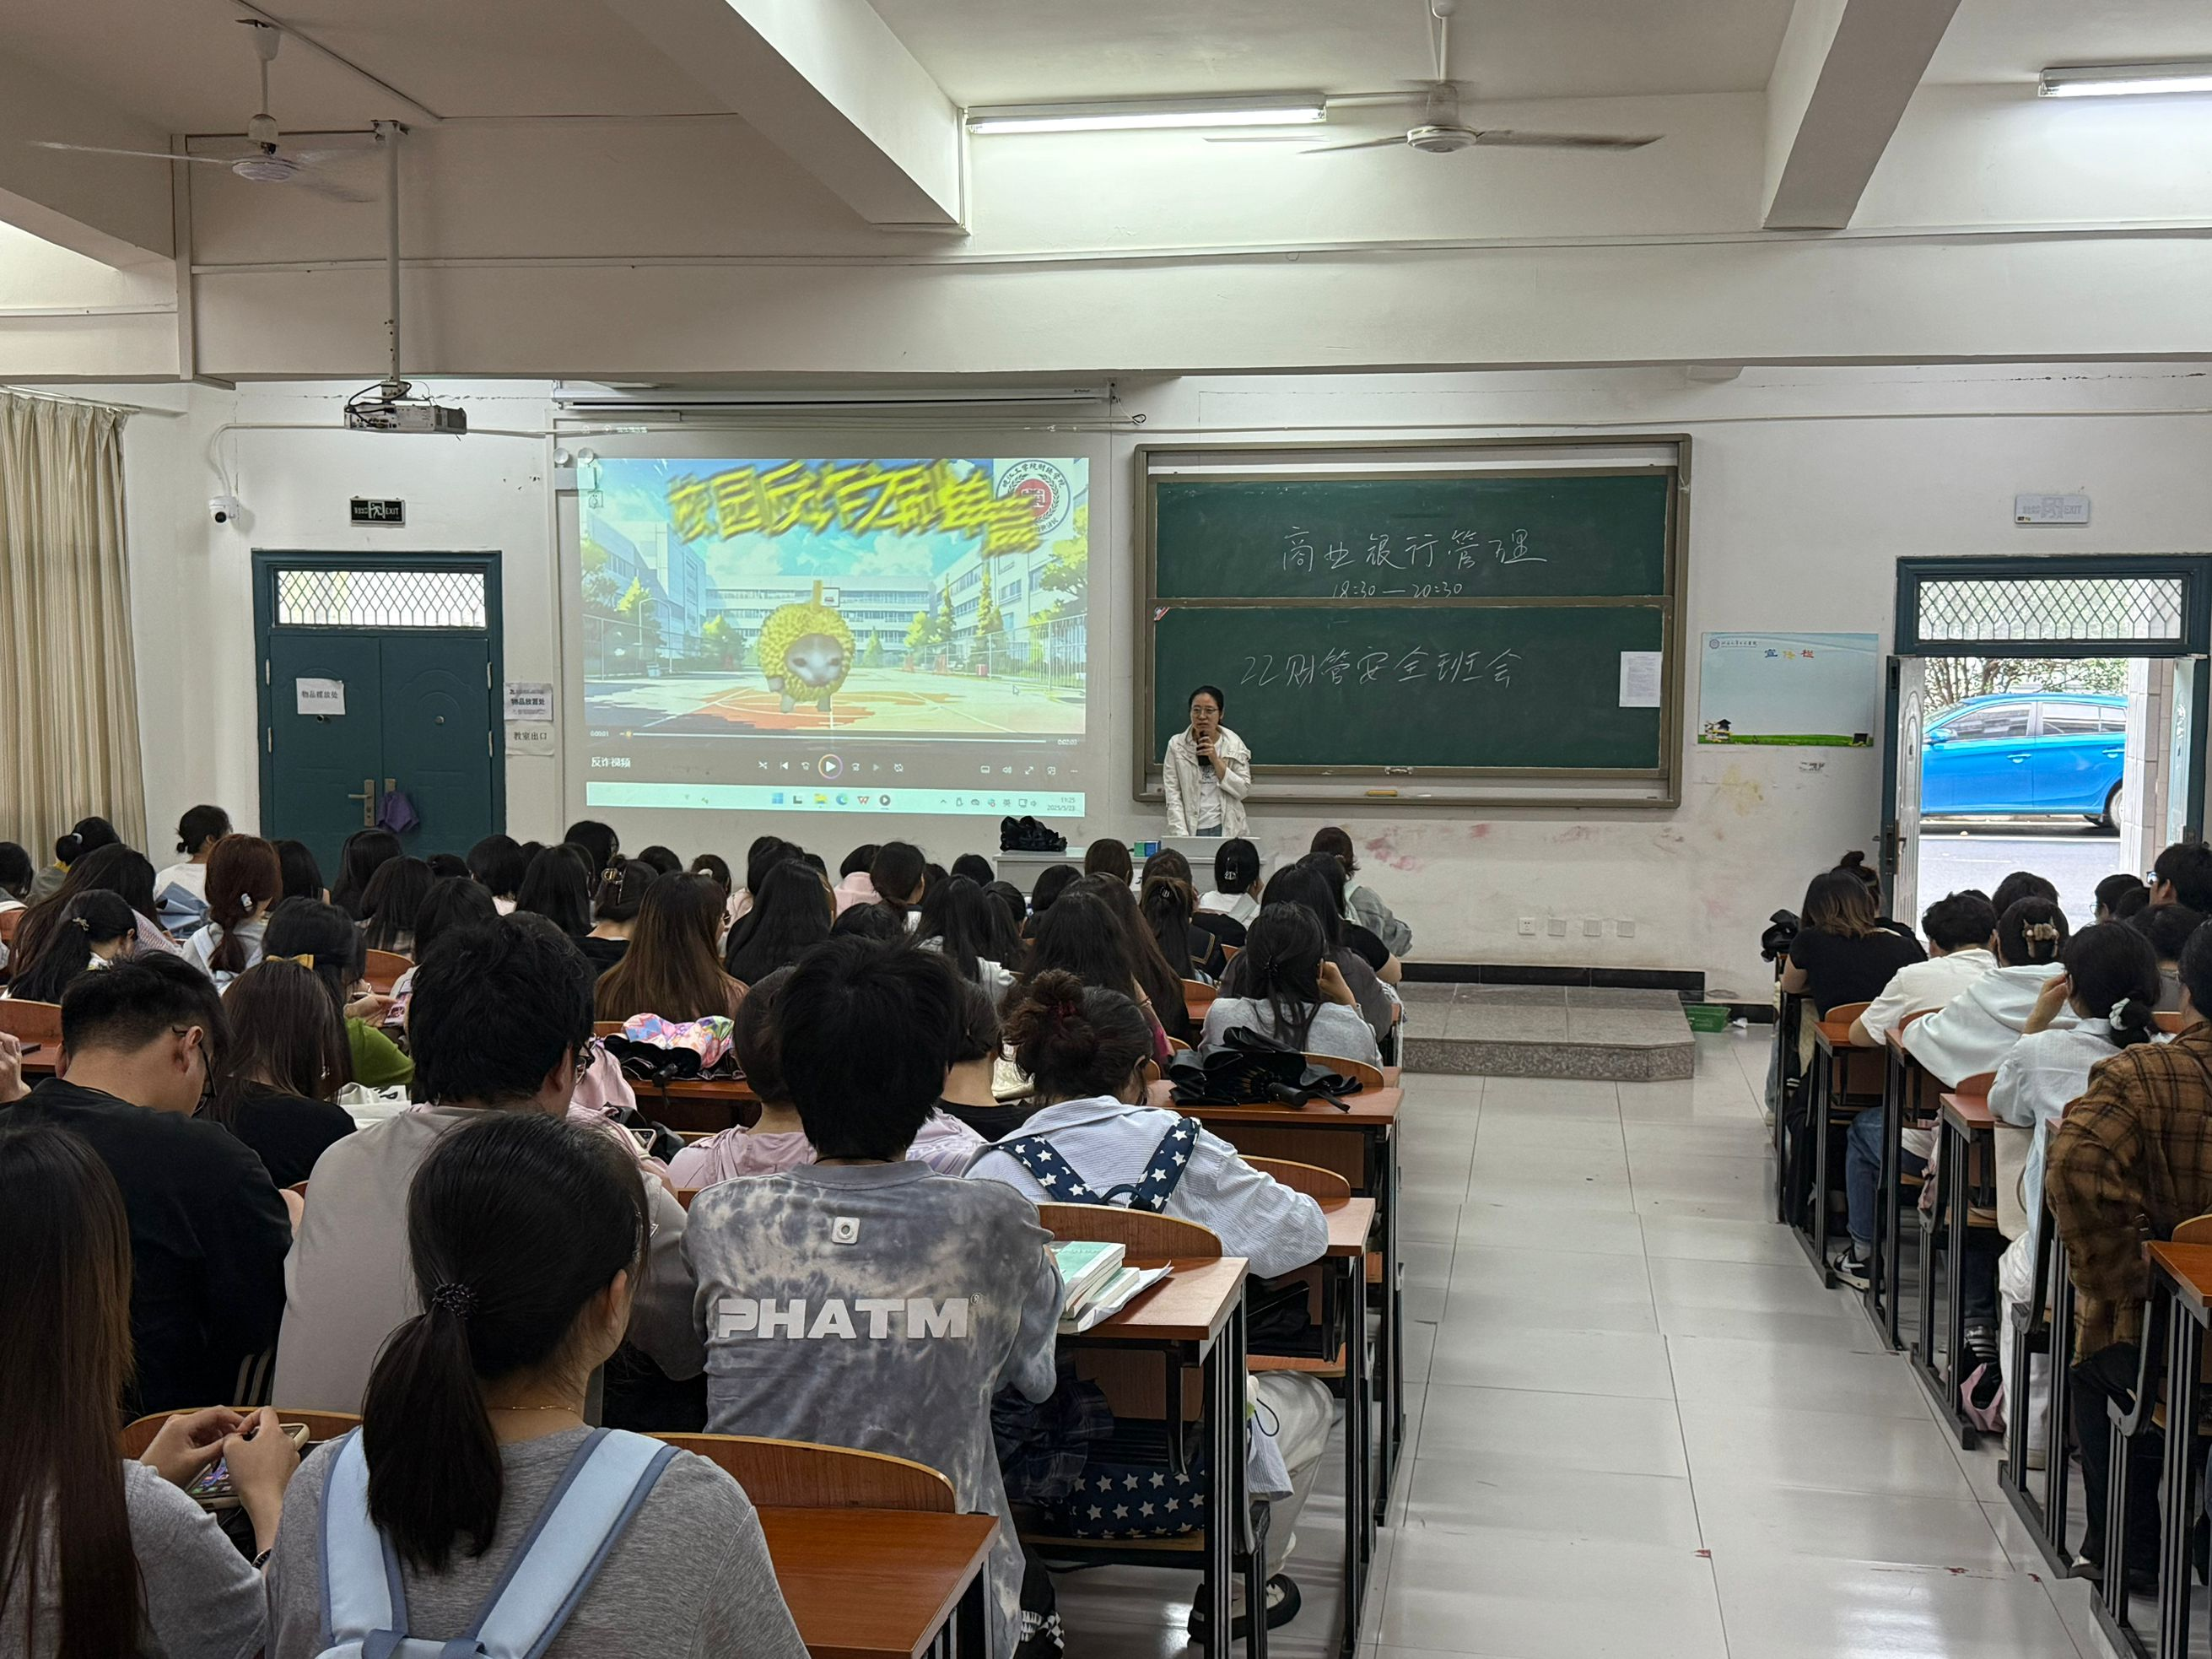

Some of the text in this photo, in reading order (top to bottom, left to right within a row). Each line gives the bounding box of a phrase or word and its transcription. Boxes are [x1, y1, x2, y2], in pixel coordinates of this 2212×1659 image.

[386, 507, 399, 516] EXIT
[1283, 527, 1547, 572] 商业银行管理
[1240, 646, 1522, 689] 22财管安全班会
[514, 732, 548, 741] 教室出口
[591, 756, 631, 768] 反诈视频
[718, 1297, 970, 1340] PHATM
